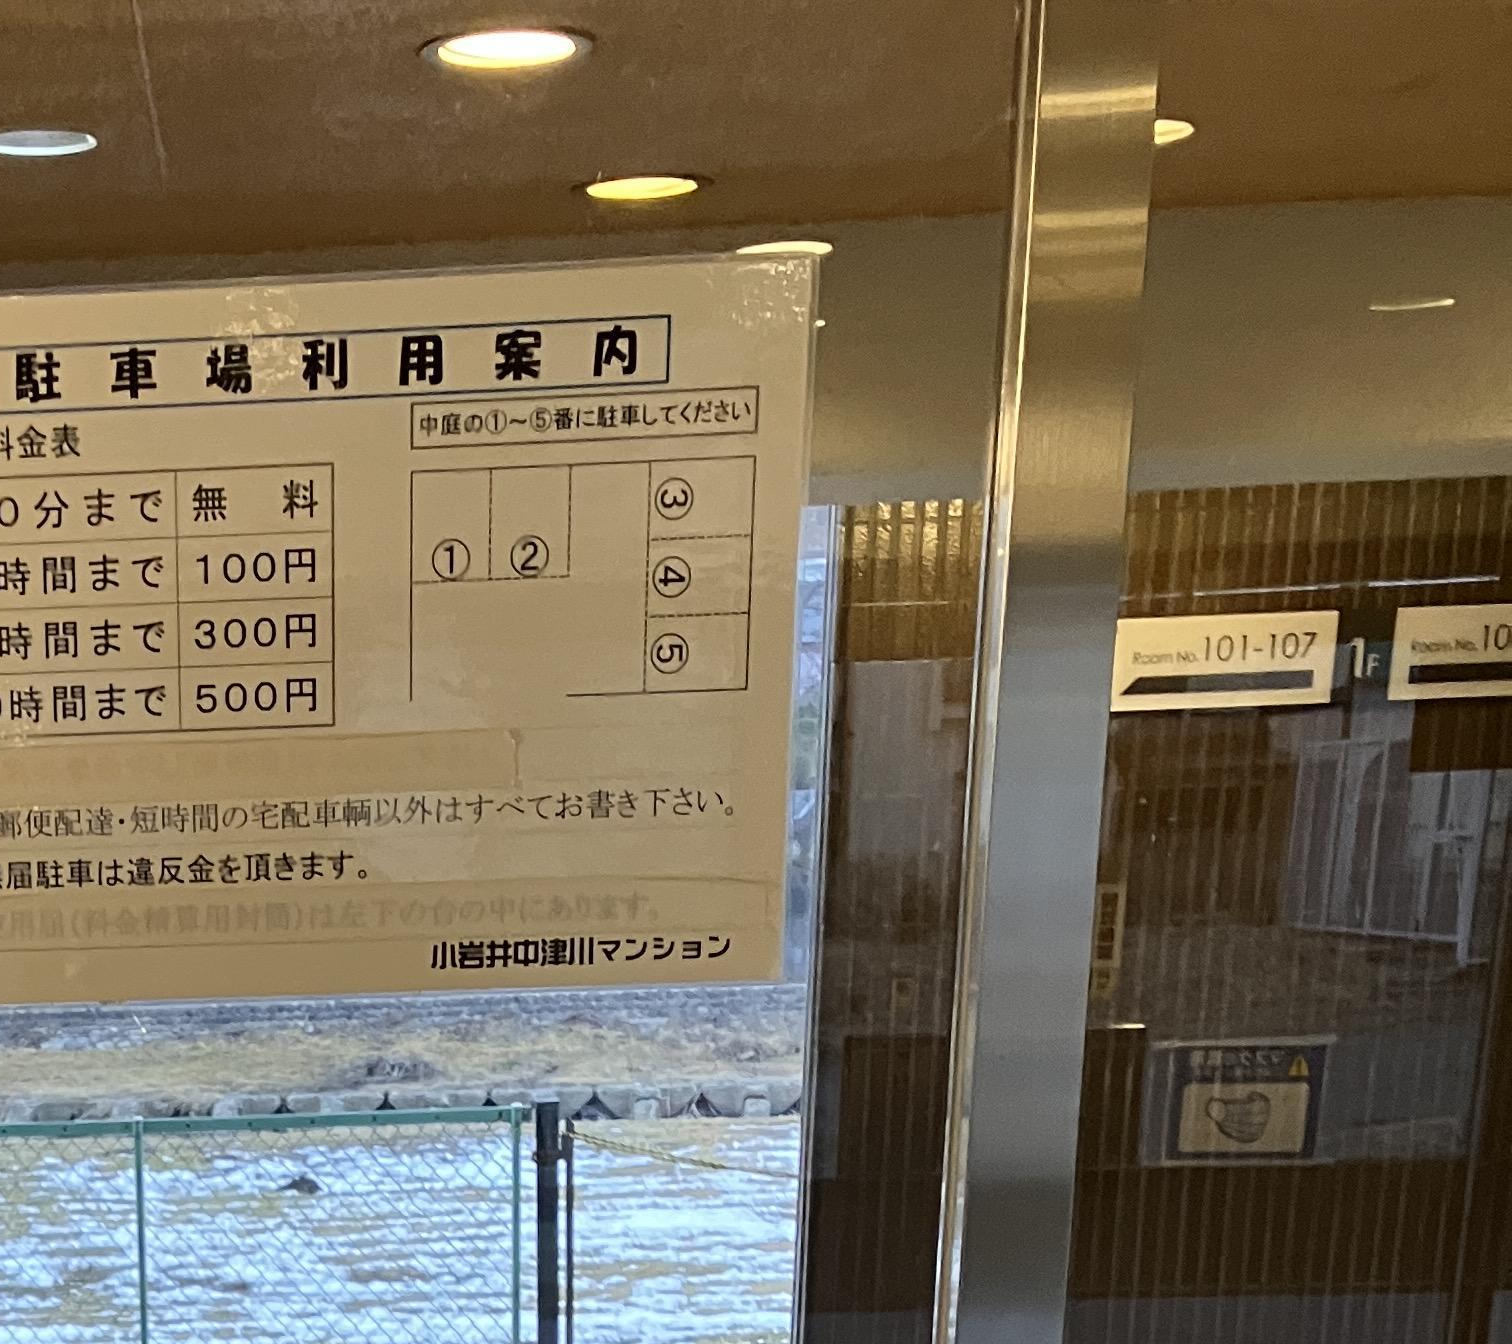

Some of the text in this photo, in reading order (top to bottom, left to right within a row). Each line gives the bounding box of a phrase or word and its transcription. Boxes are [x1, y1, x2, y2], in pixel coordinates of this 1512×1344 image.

[15, 325, 641, 403] 駐車場利用案内
[196, 548, 317, 585] 100円
[193, 613, 317, 651] 300円
[1203, 632, 1317, 661] 101-107
[195, 679, 318, 716] 500円
[431, 936, 732, 970] 小岩井中津川マンション
